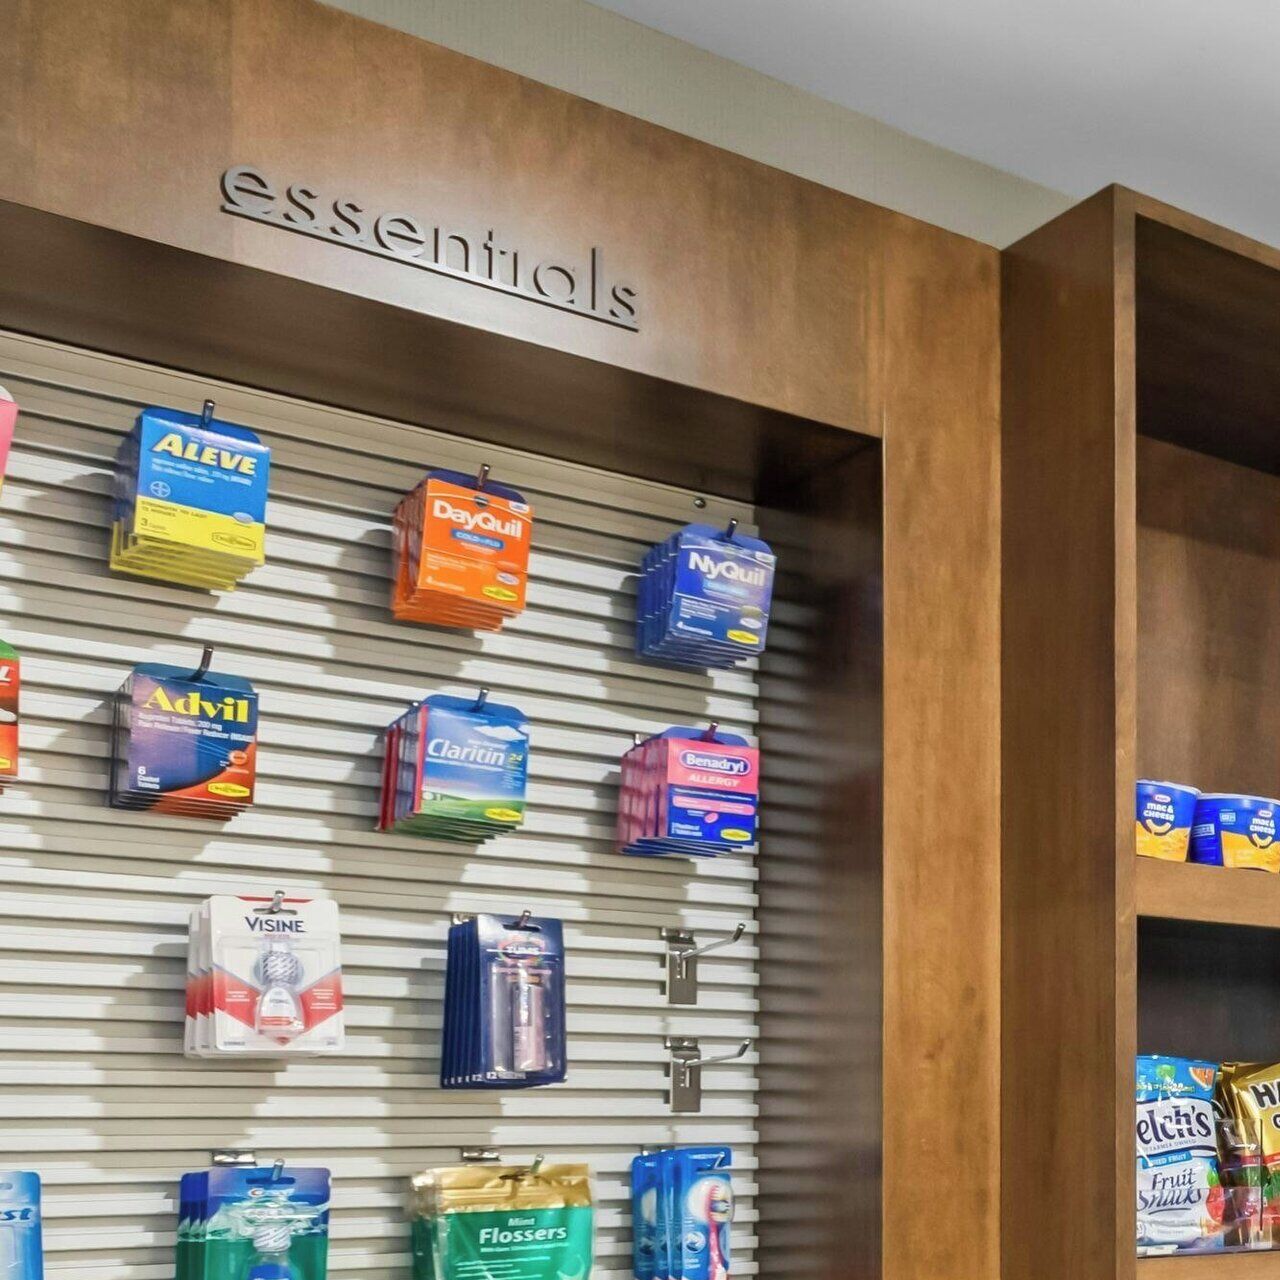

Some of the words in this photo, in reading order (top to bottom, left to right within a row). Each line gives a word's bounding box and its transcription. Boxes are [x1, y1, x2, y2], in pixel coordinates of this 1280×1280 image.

[221, 164, 641, 324] essentials
[152, 432, 258, 475] ALEVE
[432, 499, 523, 540] DayQuil
[688, 552, 767, 587] NyQuil
[142, 686, 249, 724] Advil
[427, 738, 506, 766] Claritin
[685, 753, 745, 774] Benadryl
[688, 774, 741, 788] ALLERGY
[1143, 810, 1175, 821] cheese
[1146, 802, 1166, 813] mac
[1166, 805, 1174, 814] &
[1249, 824, 1276, 835] cheese
[1252, 817, 1269, 827] mac
[1269, 819, 1276, 828] &
[244, 916, 306, 933] VISINE
[1136, 1104, 1212, 1146] elch's
[1152, 1169, 1197, 1190] Fruit
[508, 1216, 535, 1227] Mint
[479, 1225, 568, 1245] Flossers
